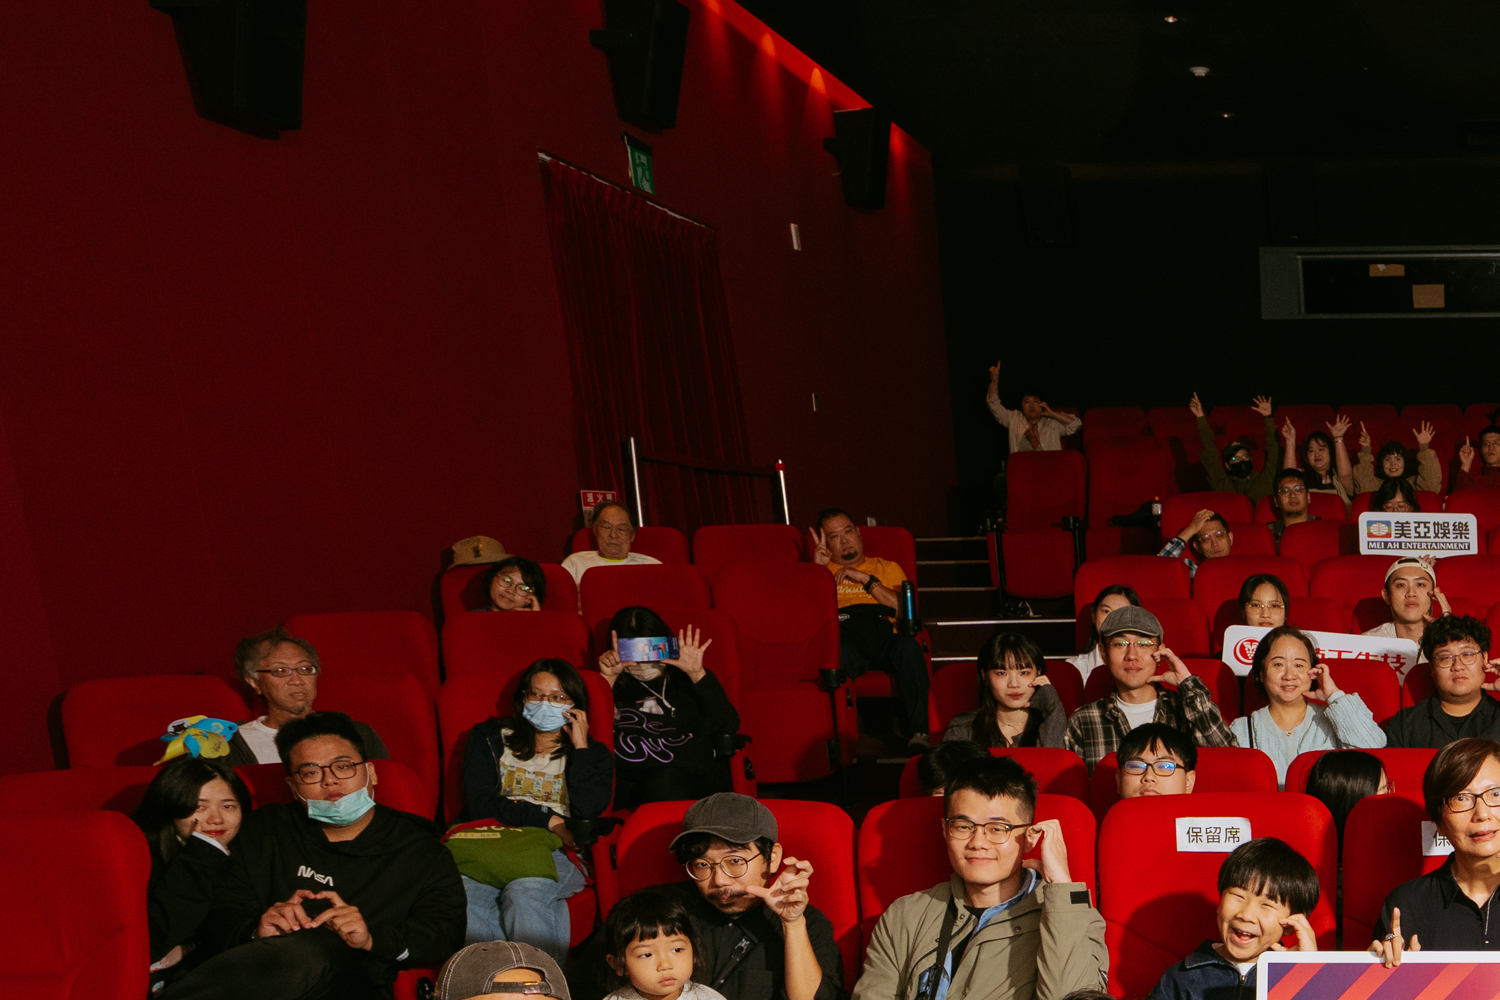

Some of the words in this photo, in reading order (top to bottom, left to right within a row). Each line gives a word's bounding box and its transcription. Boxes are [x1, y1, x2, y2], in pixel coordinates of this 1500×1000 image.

[1394, 521, 1470, 539] 美亞娛樂
[1369, 541, 1385, 549] MEI
[1402, 542, 1470, 550] ENTERTAINMENT
[1186, 826, 1241, 844] 保留席
[297, 865, 334, 887] NASA
